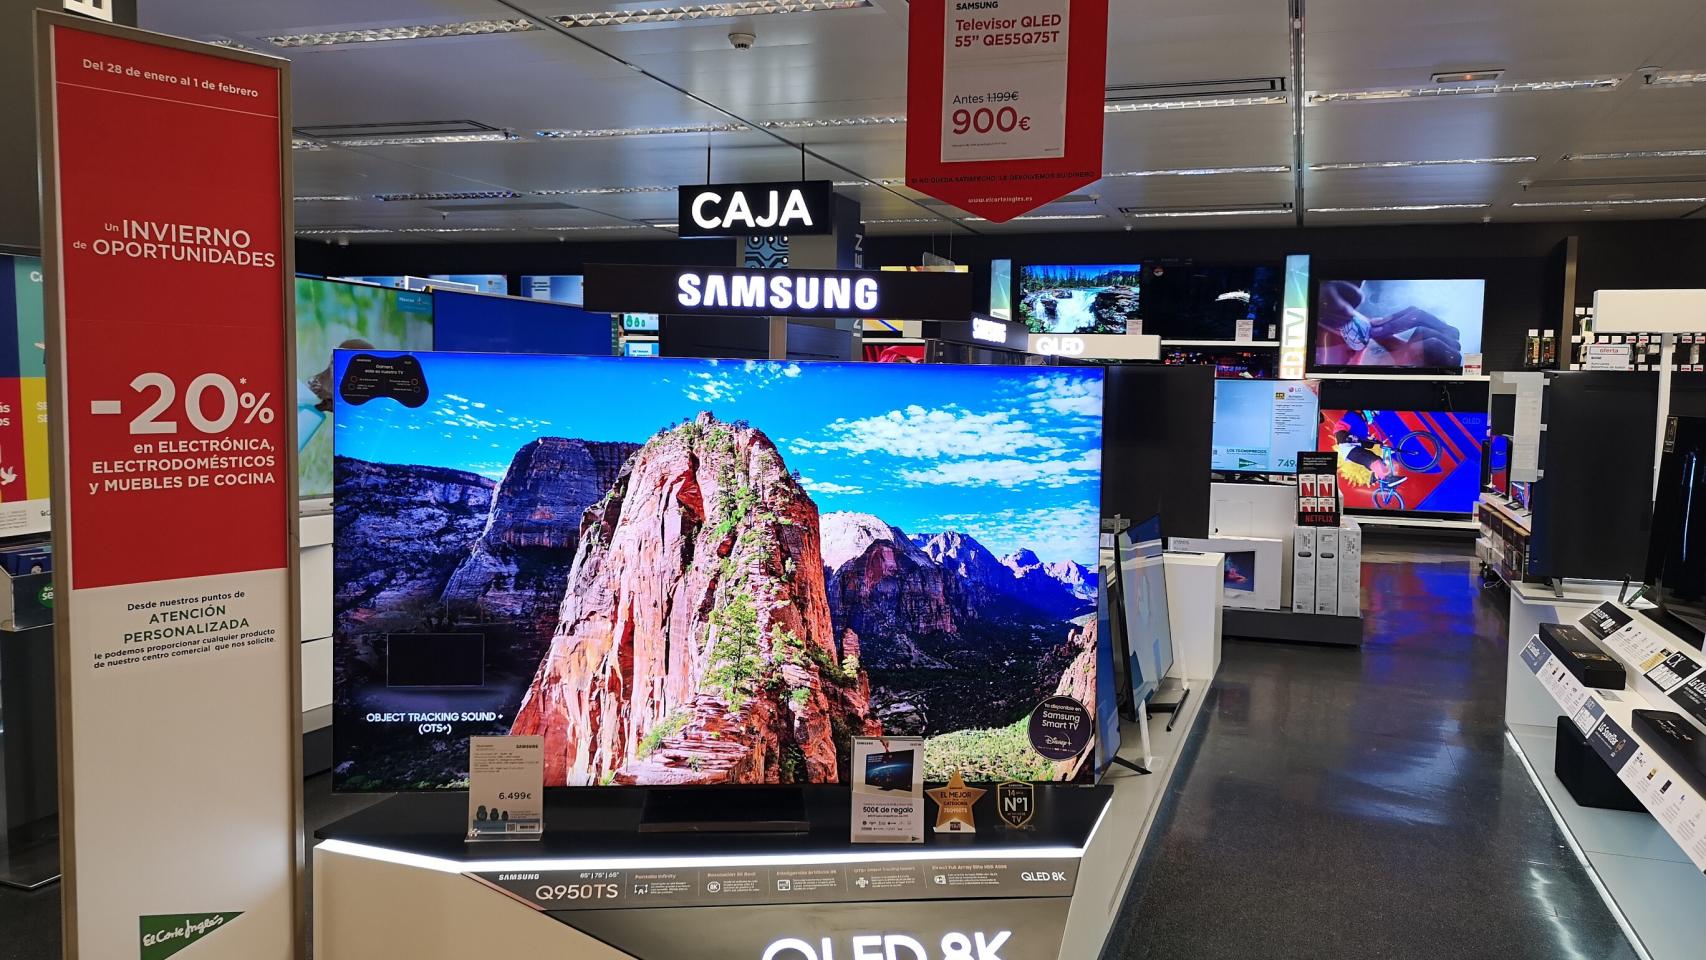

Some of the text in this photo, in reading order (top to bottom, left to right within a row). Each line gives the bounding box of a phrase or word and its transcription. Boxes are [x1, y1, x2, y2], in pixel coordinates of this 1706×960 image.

[956, 1, 999, 10] SAMSUNG
[956, 14, 1061, 31] Televisor QLED
[983, 31, 1059, 46] QE55Q75T
[83, 59, 258, 97] Del 28 de enero al 1 de febrero
[953, 91, 1018, 105] Antes 1.199€
[953, 106, 1030, 134] 900€
[691, 189, 813, 229] CAJA
[105, 219, 250, 248] Un INVIERNO
[73, 239, 275, 267] de OPORTUNIDADES
[677, 273, 879, 310] SAMSUNG
[134, 436, 275, 454] en ELECTRÓNICA,
[92, 455, 275, 474] ELECTRODOMÉSTICOS
[89, 472, 275, 494] y MUEBLES DE COCINA
[127, 601, 157, 611] Desde
[160, 596, 199, 607] nuestros
[201, 592, 232, 604] puntos
[149, 604, 226, 624] ATENCIÓN
[124, 618, 250, 644] PERSONALIZADA
[105, 648, 144, 659] podemos
[147, 639, 200, 653] proporcionar
[202, 634, 238, 644] cualquier
[241, 629, 275, 640] producto
[94, 661, 105, 669] de
[108, 656, 140, 667] nuestro
[142, 652, 169, 661] centro
[171, 646, 210, 657] comercial
[214, 643, 229, 651] que
[1666, 653, 1686, 667] CX
[367, 713, 406, 722] OBJECT
[408, 712, 459, 722] TRACKING
[461, 712, 496, 721] SOUND
[1042, 711, 1080, 723] Samsung
[1042, 720, 1067, 729] Smart
[418, 723, 452, 735] (OTS+)
[498, 792, 532, 800] 6.499€
[498, 873, 540, 881] SAMSUNG
[1021, 871, 1066, 882] QLED 8K
[535, 884, 618, 900] Q950TS
[156, 927, 184, 943] Corte
